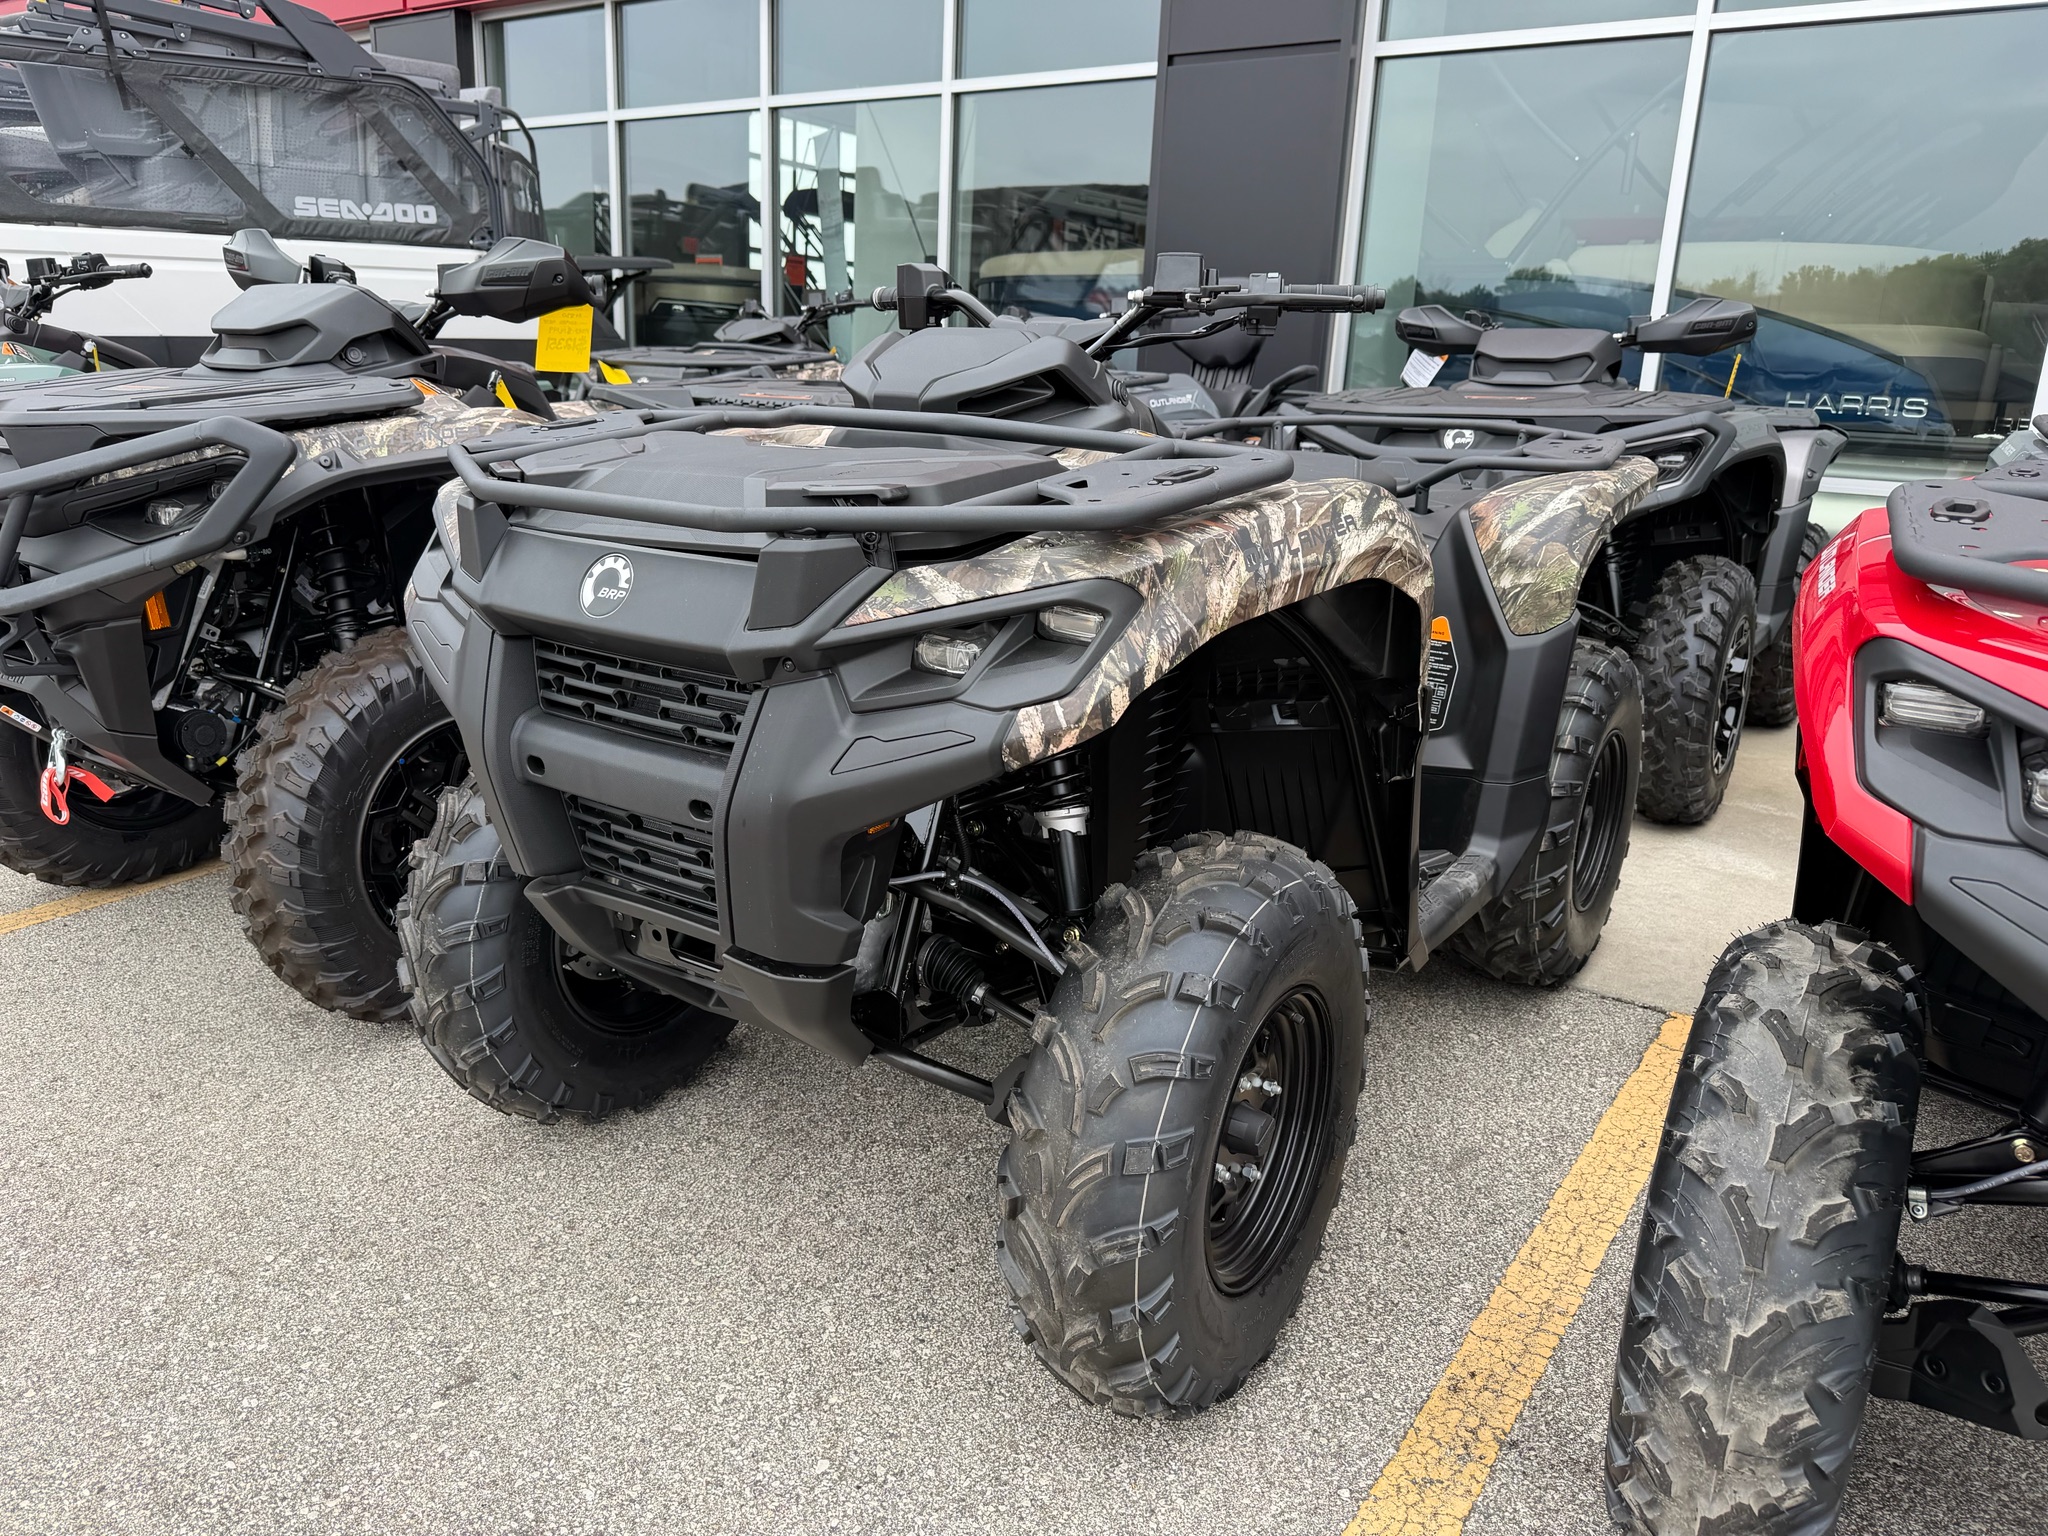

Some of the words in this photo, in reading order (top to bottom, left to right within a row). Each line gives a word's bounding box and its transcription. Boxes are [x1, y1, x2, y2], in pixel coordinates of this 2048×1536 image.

[1149, 394, 1193, 408] OUTLANDER
[1784, 391, 1929, 419] HARRIS
[1243, 513, 1358, 573] OUTLANDER
[597, 586, 627, 600] BRP
